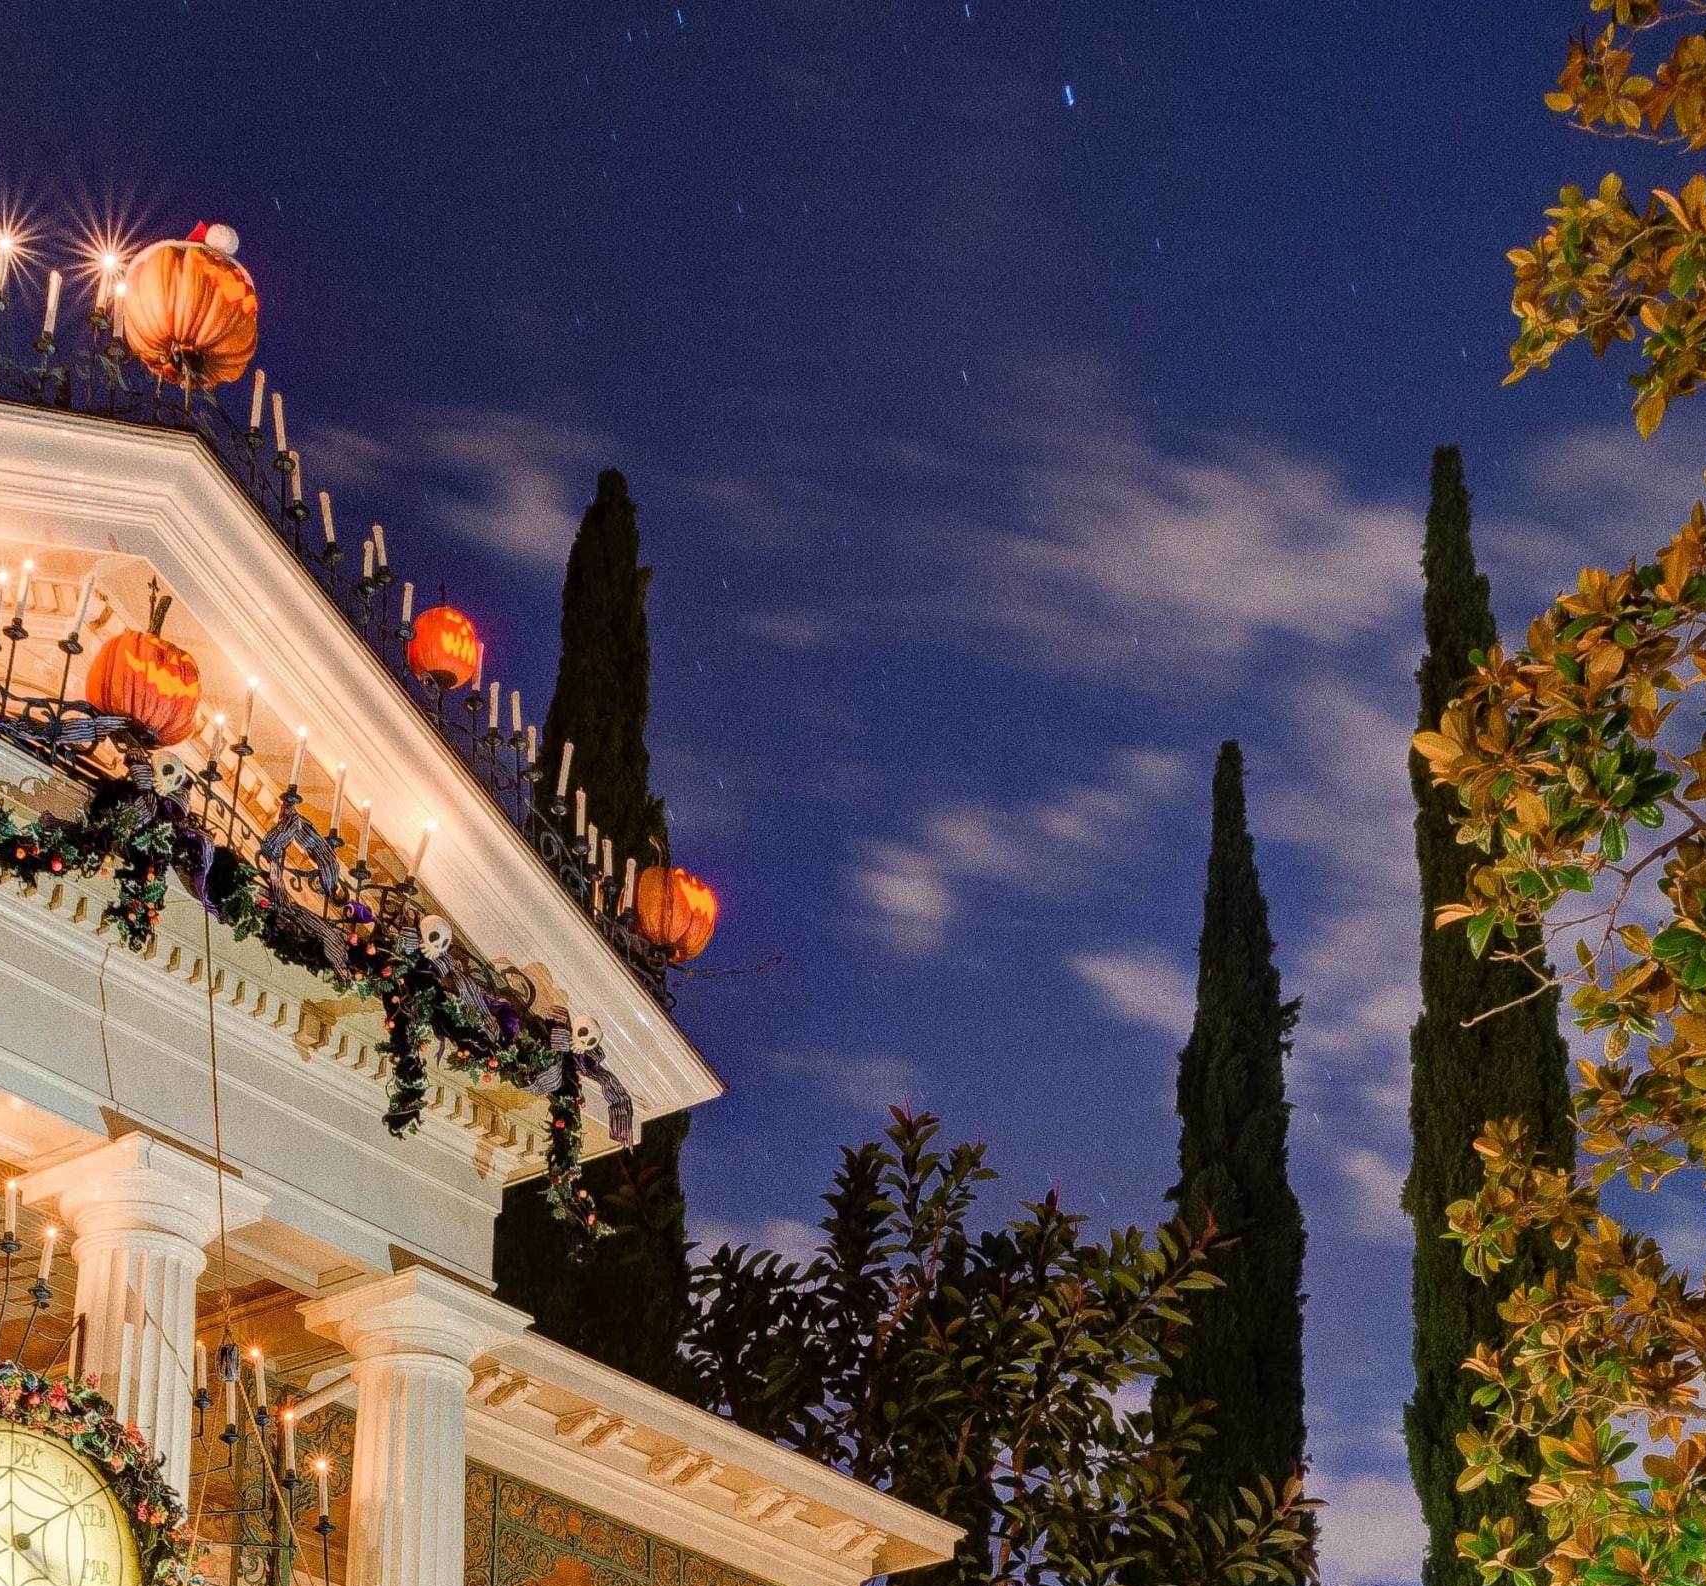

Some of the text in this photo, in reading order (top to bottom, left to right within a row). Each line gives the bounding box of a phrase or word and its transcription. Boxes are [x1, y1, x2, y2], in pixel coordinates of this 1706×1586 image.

[12, 1440, 42, 1469] DEC
[57, 1465, 84, 1495] JAN
[82, 1504, 105, 1527] FEB
[82, 1559, 112, 1584] MAR
